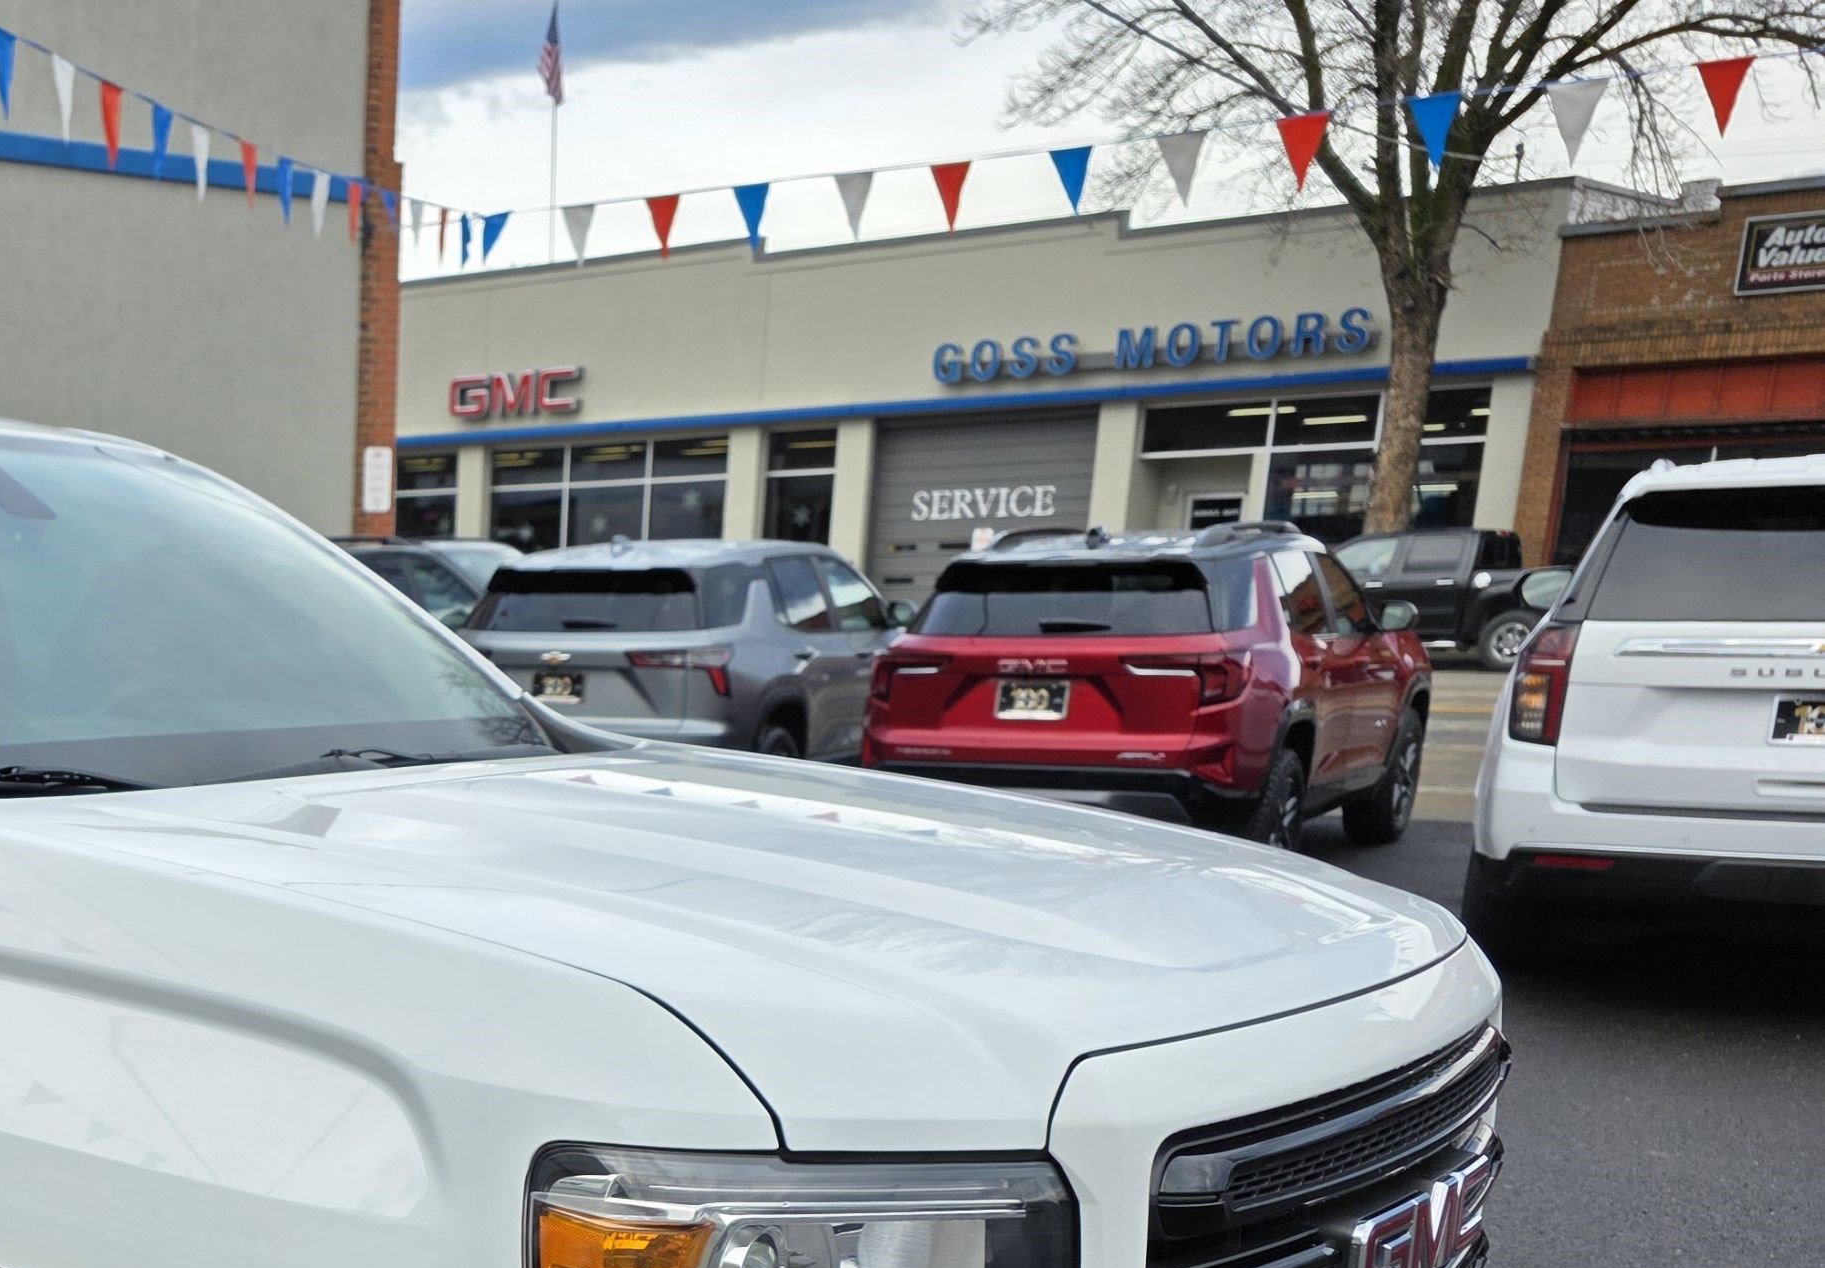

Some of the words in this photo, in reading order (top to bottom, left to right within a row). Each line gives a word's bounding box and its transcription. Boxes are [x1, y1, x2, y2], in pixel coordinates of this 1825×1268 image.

[1763, 224, 1825, 248] Auto
[1758, 245, 1825, 268] Value
[933, 333, 1078, 384] GOSS
[1114, 307, 1372, 370] MOTORS
[448, 366, 582, 419] GMC
[910, 485, 1057, 521] SERVICE
[997, 658, 1069, 675] GMC
